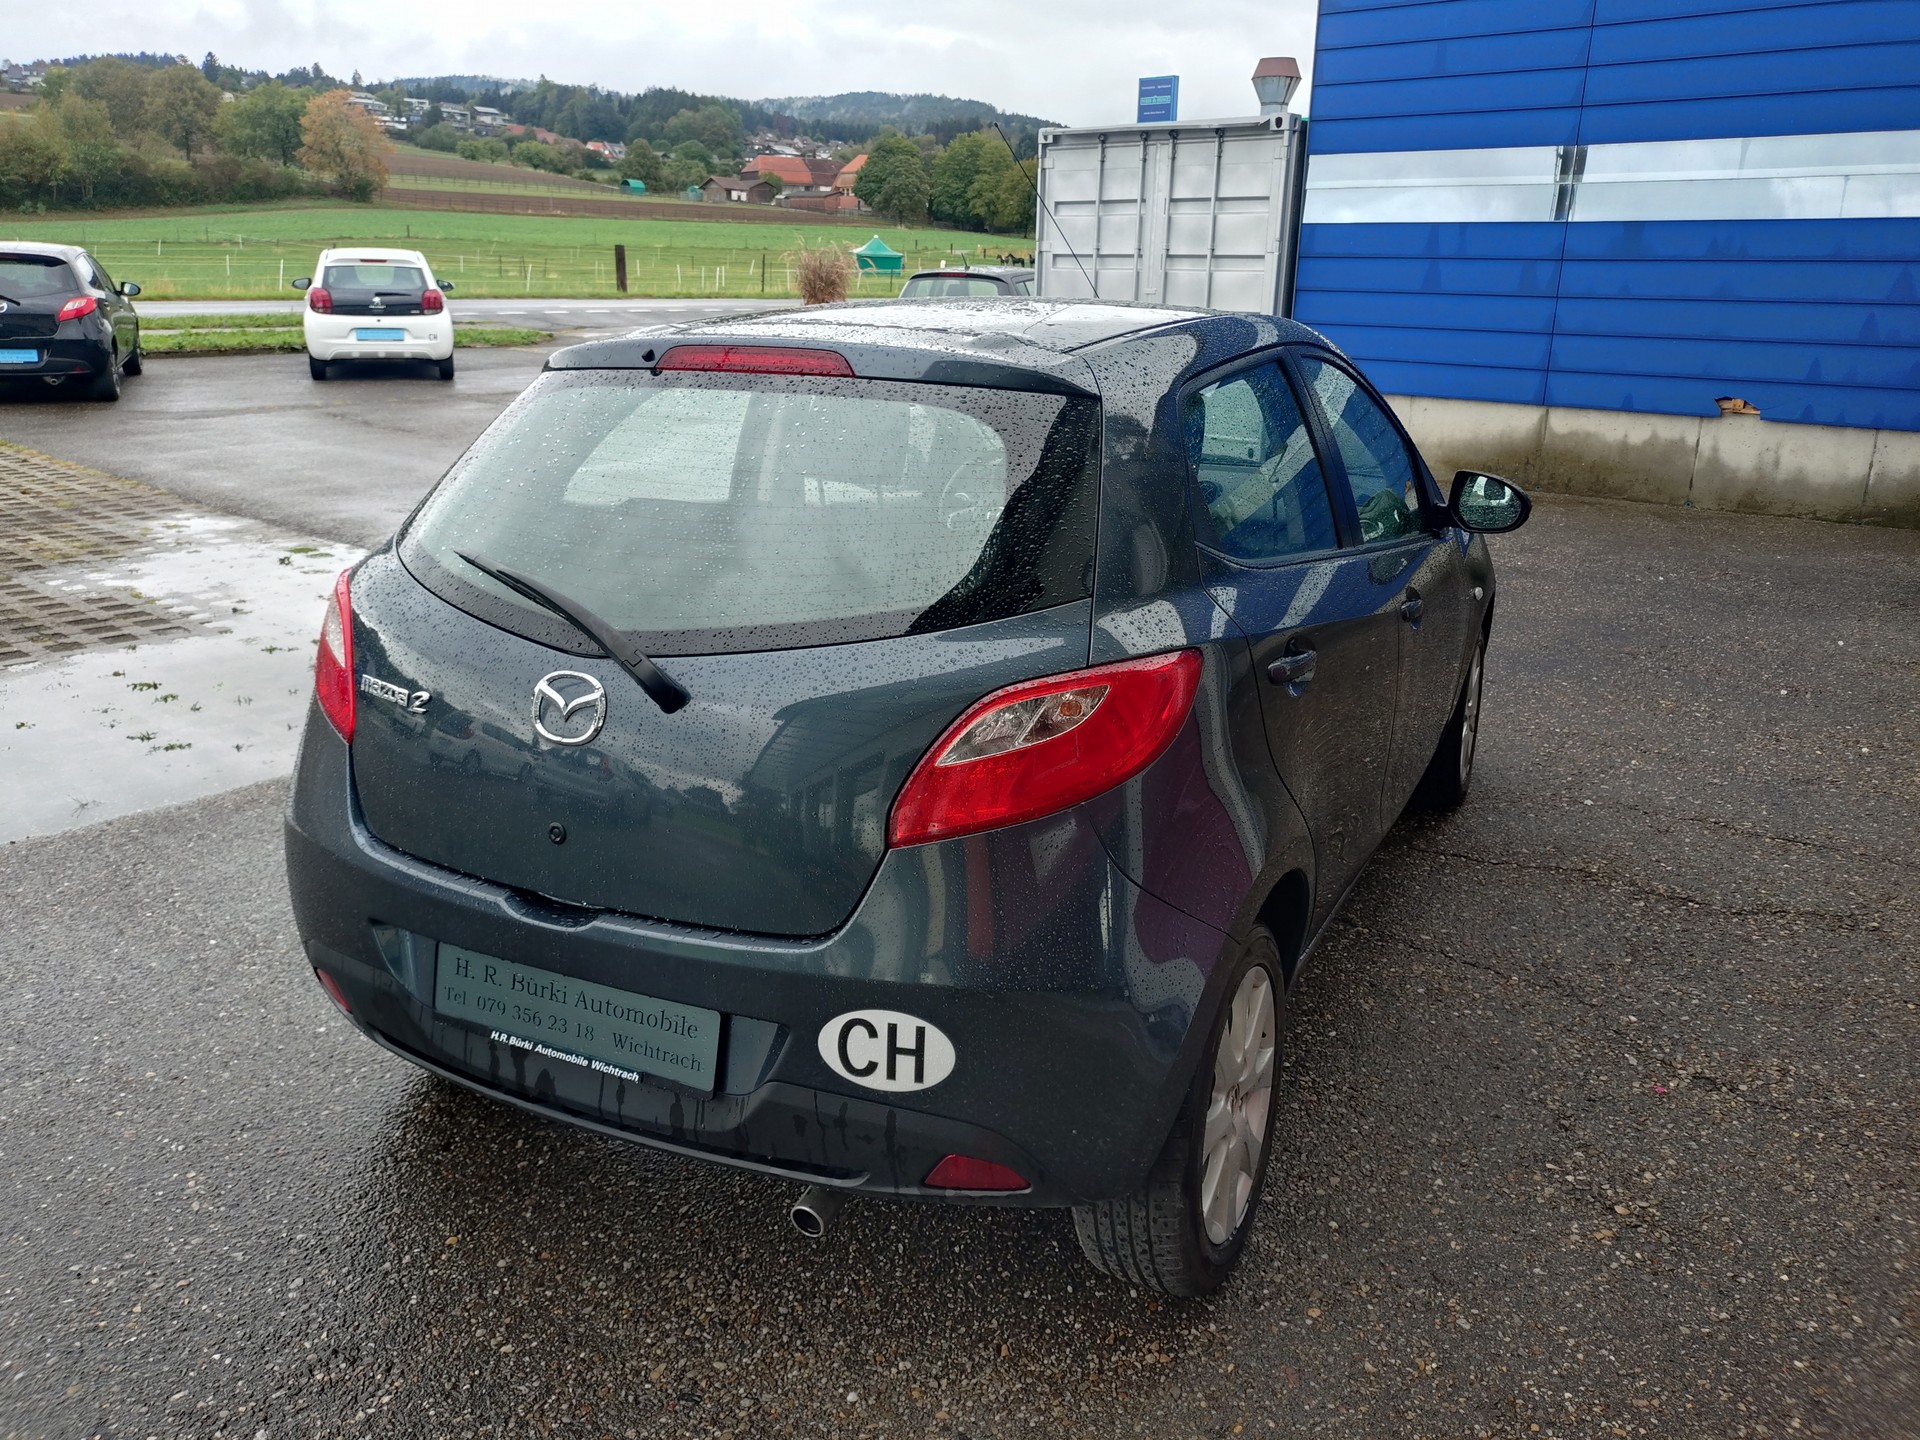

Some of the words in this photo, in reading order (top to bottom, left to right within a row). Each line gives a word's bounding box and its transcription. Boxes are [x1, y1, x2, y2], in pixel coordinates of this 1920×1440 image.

[455, 957, 475, 980] H.
[483, 964, 502, 987] R.
[510, 972, 568, 1005] Bürki
[574, 990, 698, 1039] Automobile
[476, 995, 506, 1016] 079
[511, 1004, 542, 1027] 356
[547, 1014, 568, 1034] 23
[576, 1022, 595, 1042] 18
[612, 1032, 702, 1072] Wichtrach
[534, 1043, 589, 1067] Automobile
[591, 1059, 640, 1083] Wichtrach
[837, 1017, 926, 1085] CH
